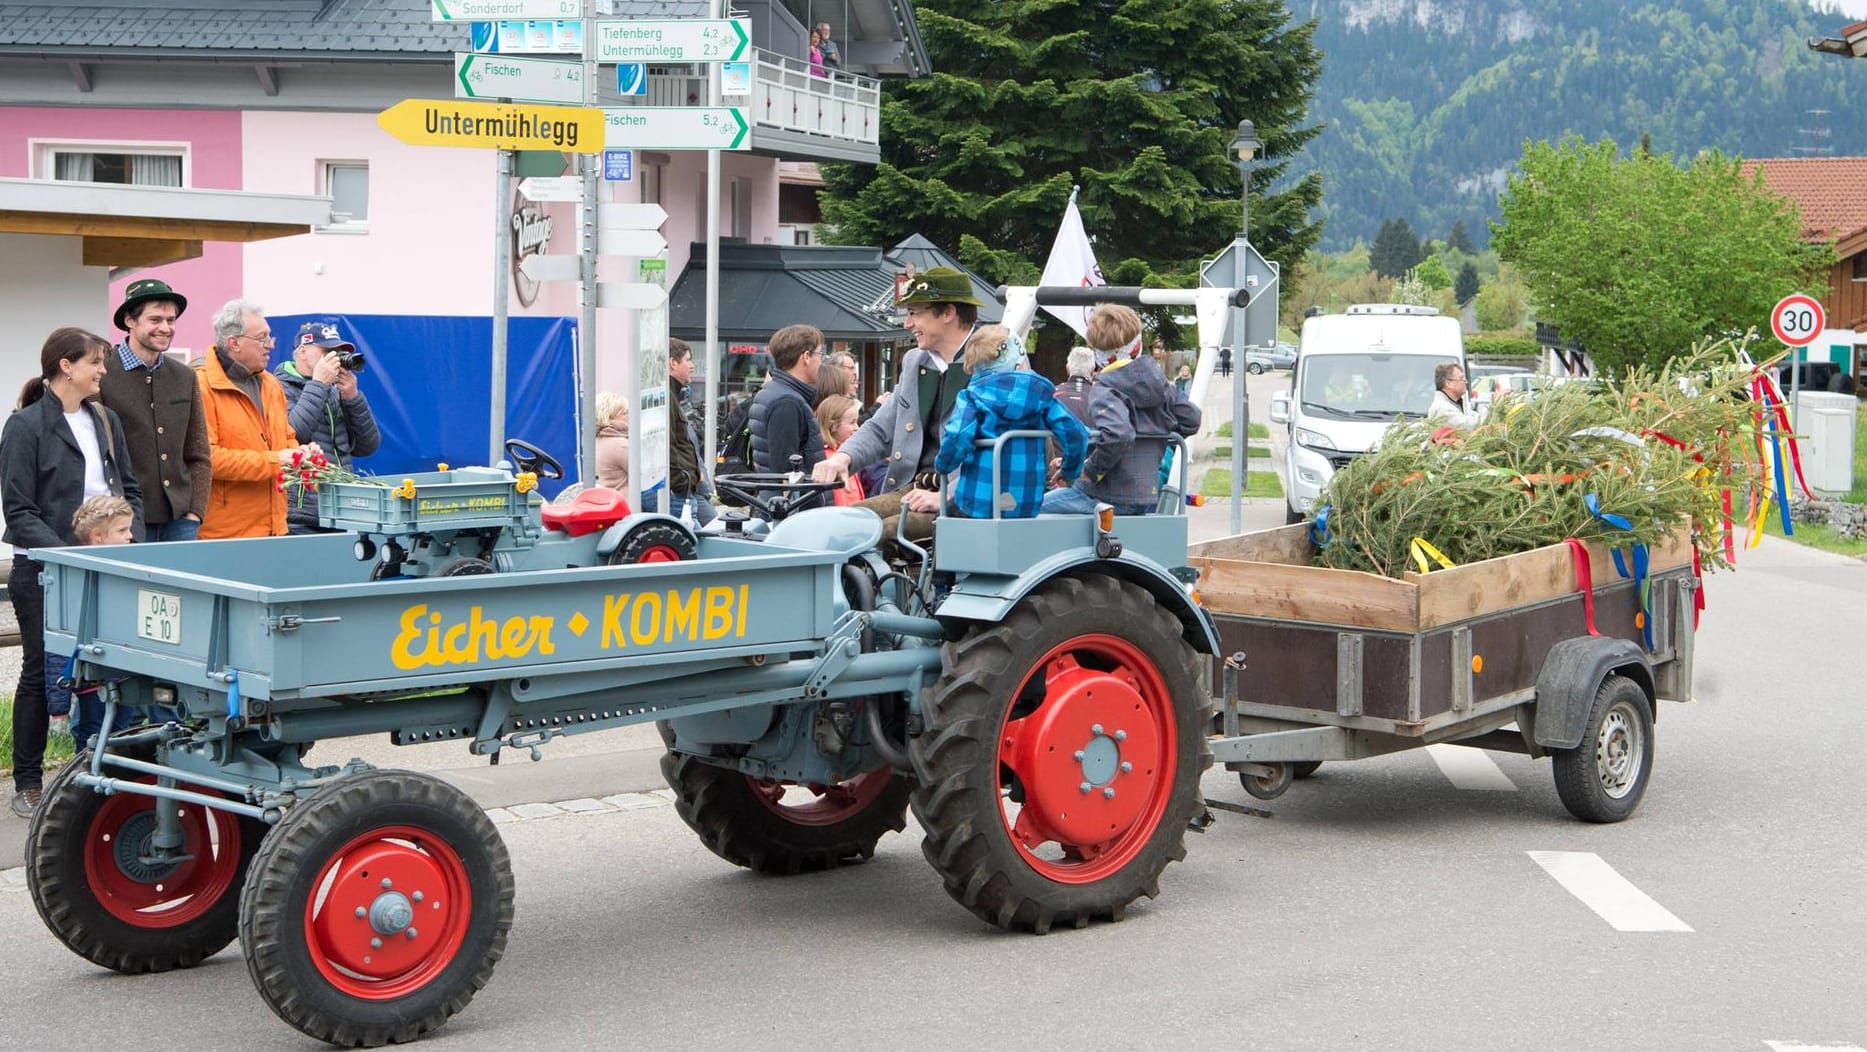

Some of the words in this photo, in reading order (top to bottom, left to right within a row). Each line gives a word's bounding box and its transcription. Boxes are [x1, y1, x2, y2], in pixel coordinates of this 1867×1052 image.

[463, 2, 524, 14] Sonderdorf
[603, 27, 662, 41] Tiefenberg
[603, 44, 683, 58] Untermühlegg
[485, 62, 521, 77] Fischen
[425, 108, 578, 147] Untermühlegg
[605, 114, 646, 126] Fischen
[512, 208, 553, 258] Vintage
[1783, 310, 1812, 332] 30
[468, 496, 506, 512] KOMBI
[152, 595, 168, 616] OA
[145, 616, 152, 636] E
[160, 619, 171, 640] 10
[391, 603, 555, 670] Eicher
[601, 583, 749, 649] KOMBI
